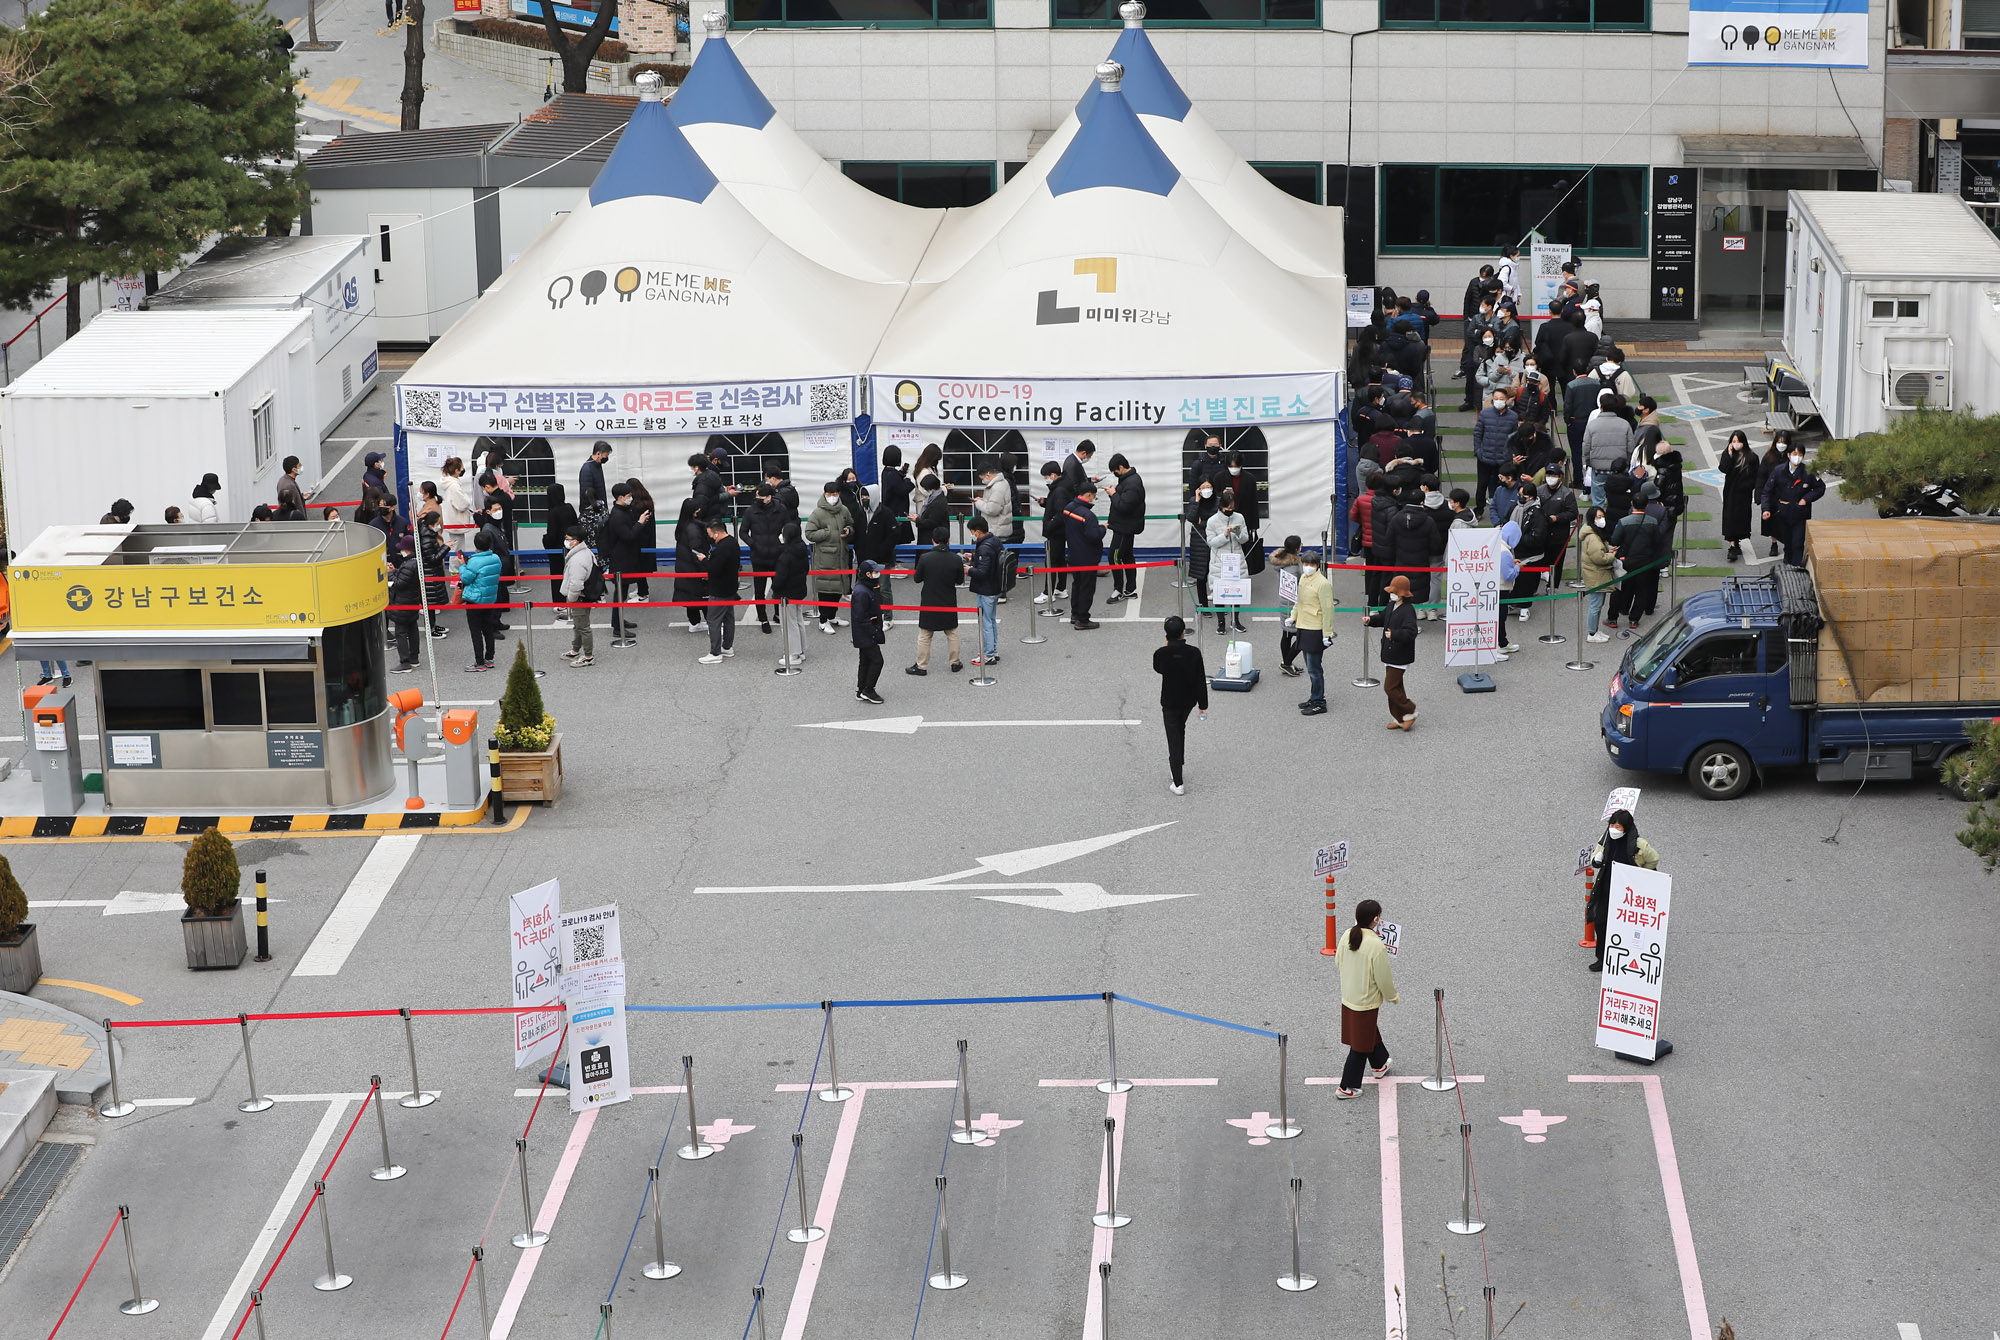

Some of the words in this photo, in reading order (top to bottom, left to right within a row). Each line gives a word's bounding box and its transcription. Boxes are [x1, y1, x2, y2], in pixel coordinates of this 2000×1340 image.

[1784, 42, 1835, 50] GANGNAM
[645, 288, 729, 306] GANGNAM
[1086, 308, 1172, 325] 미미위강남
[448, 391, 507, 413] 강남구
[514, 392, 616, 413] 선별진료소
[623, 390, 713, 413] QR코드로
[719, 384, 803, 410] 신속검사
[938, 382, 1033, 400] COVID-19
[938, 401, 1063, 425] Screening
[1076, 400, 1166, 424] Facility
[1178, 394, 1311, 424] 선별진료소
[489, 418, 536, 431] 카메라앱
[542, 418, 565, 431] 실행
[596, 418, 638, 431] QR코드
[642, 417, 666, 430] 촬영
[697, 415, 734, 428] 문진표
[739, 414, 763, 427] 작성
[104, 585, 263, 609] 강남구보건소
[1622, 886, 1657, 912] 사회적
[562, 914, 588, 927] 코로나19
[589, 912, 601, 922] 검사
[603, 910, 615, 919] 안내
[1616, 908, 1664, 930] 거리두기
[1606, 996, 1637, 1013] 거리두기
[1639, 1003, 1654, 1017] 간격
[1604, 1010, 1652, 1031] 유지해주세요
